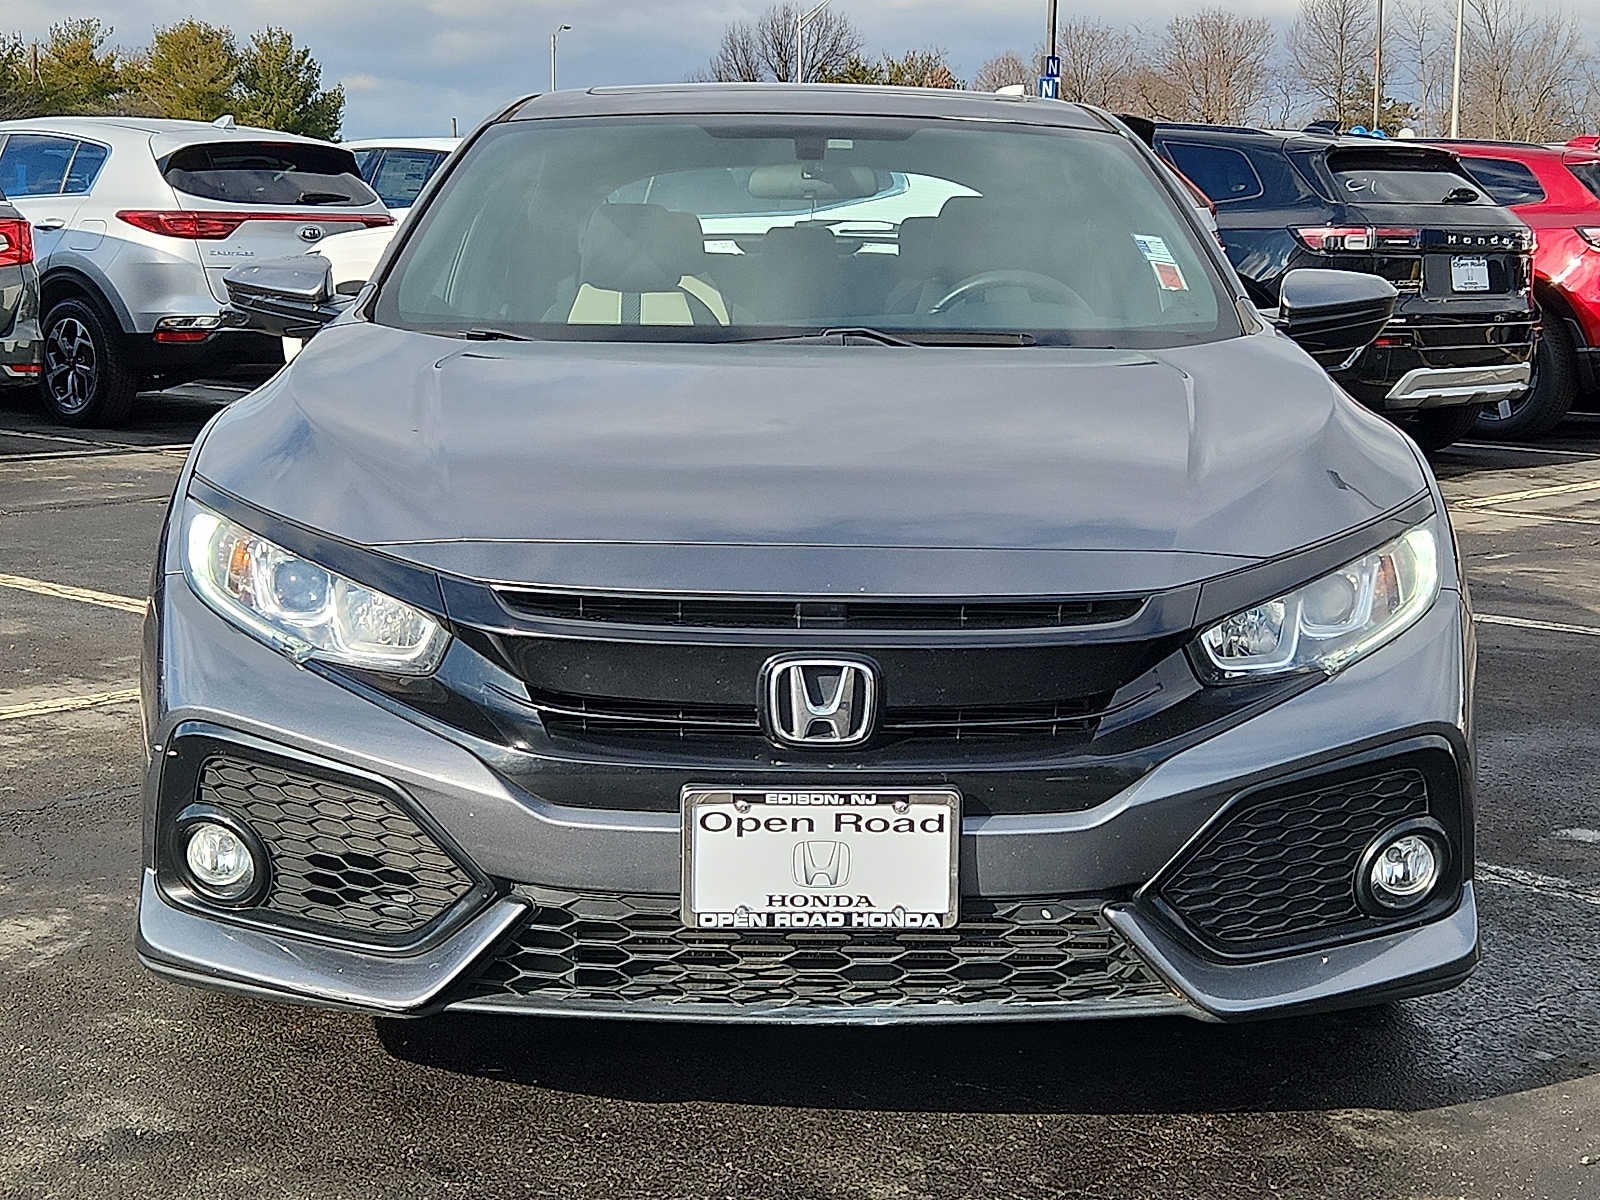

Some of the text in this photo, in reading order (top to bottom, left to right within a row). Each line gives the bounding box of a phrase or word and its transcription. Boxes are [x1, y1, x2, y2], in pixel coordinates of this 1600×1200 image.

[1048, 59, 1058, 75] N
[1041, 80, 1053, 99] N
[765, 793, 877, 805] EDISON, NJ
[699, 811, 945, 838] Open Road
[766, 894, 876, 908] HONDA
[699, 912, 941, 928] OPEN ROAD HONDA
